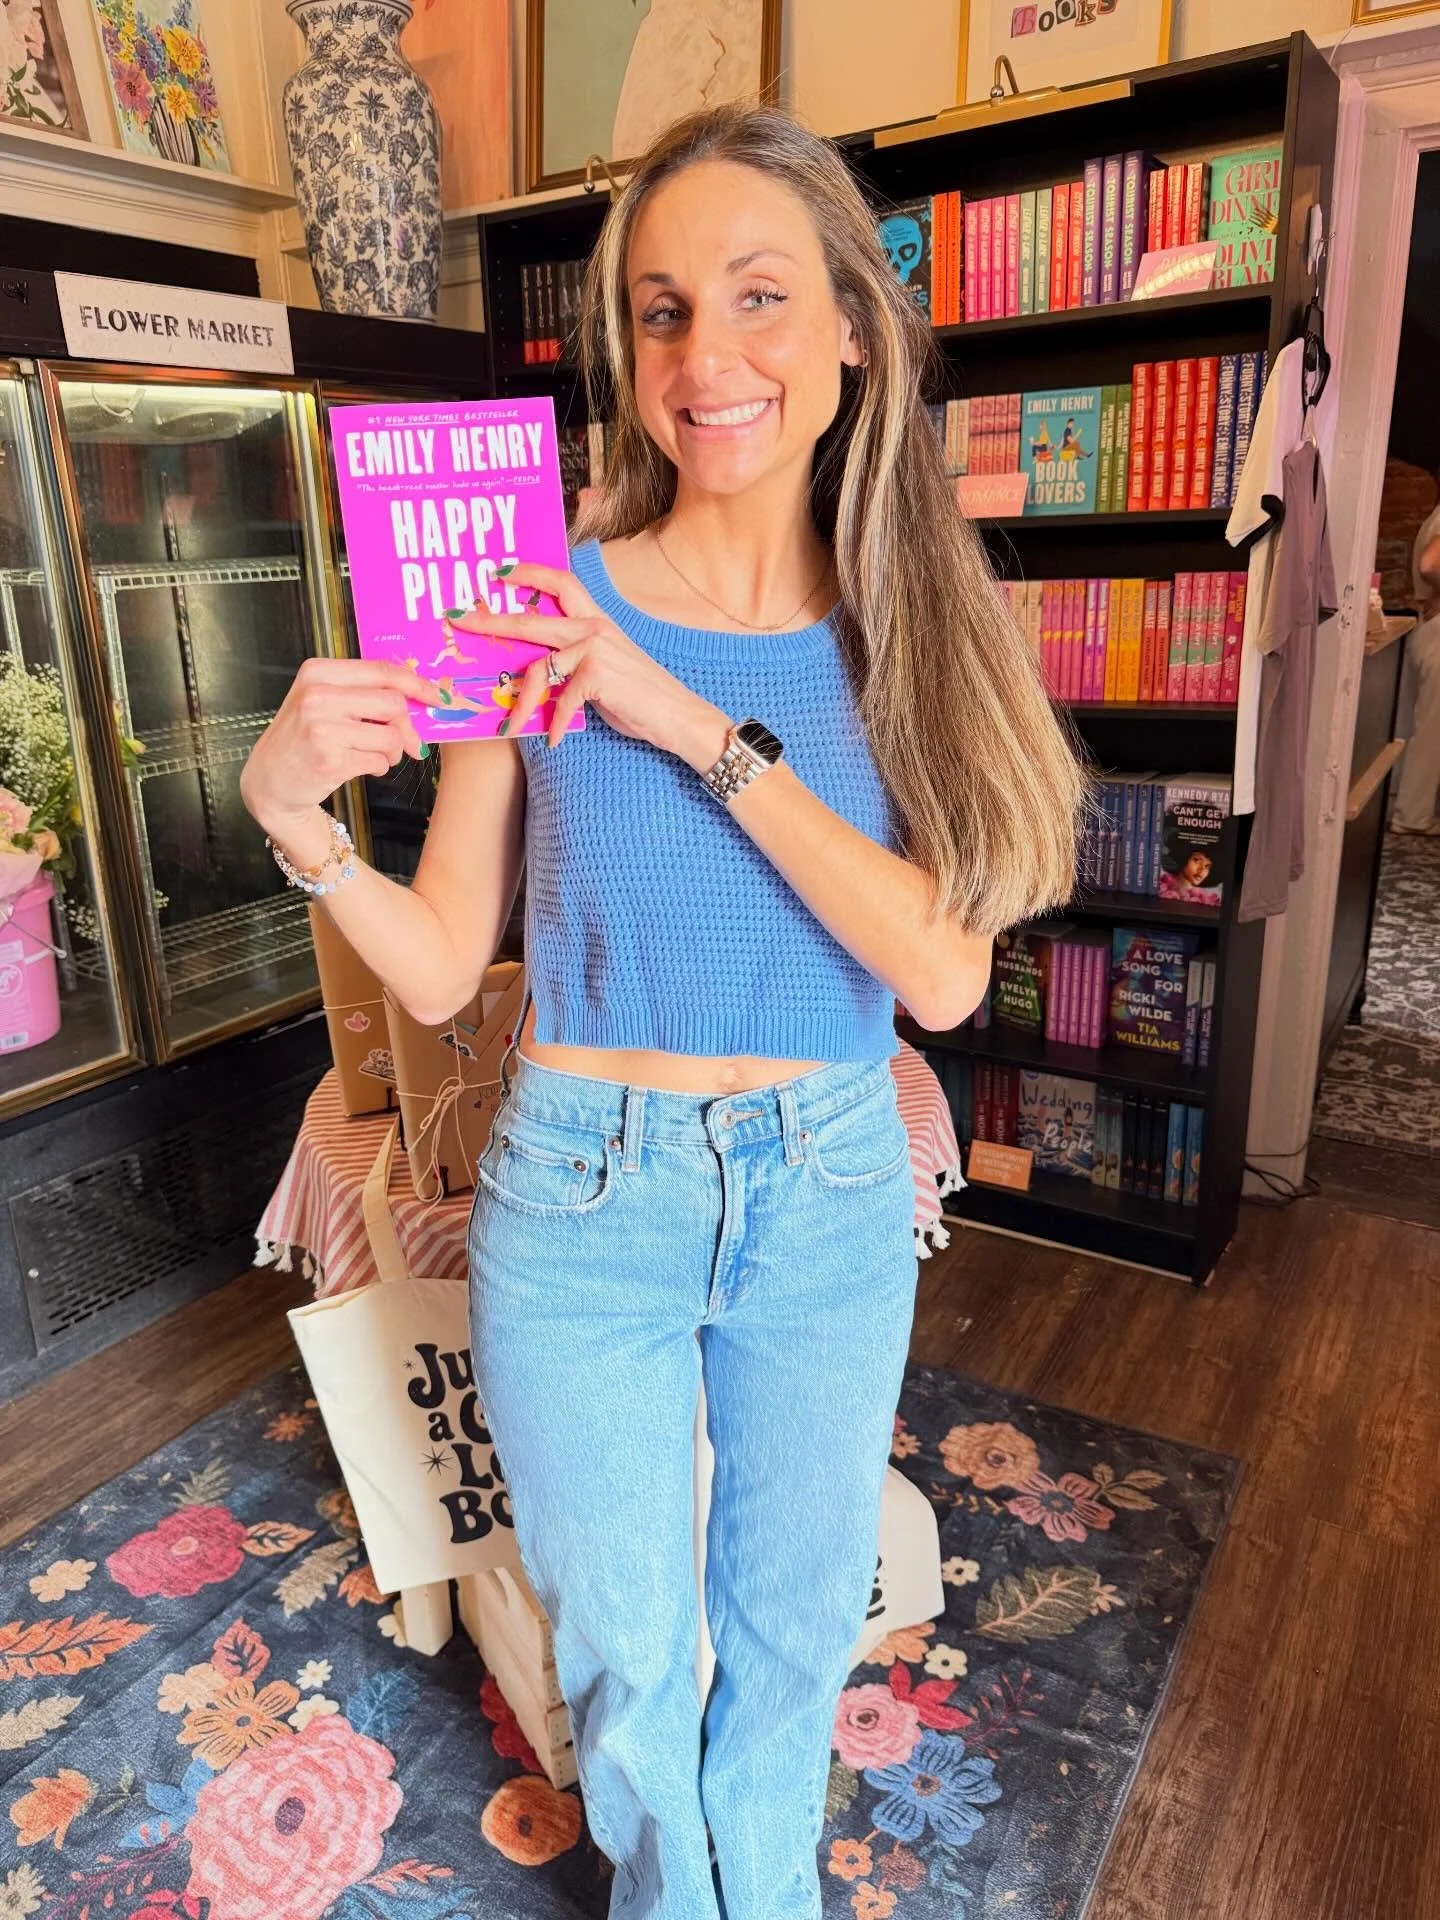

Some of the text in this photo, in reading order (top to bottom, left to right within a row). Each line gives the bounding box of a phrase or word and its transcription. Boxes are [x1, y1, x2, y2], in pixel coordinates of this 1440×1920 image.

[1211, 263, 1272, 289] BLAK
[79, 305, 274, 347] FLOWER MARKET
[1027, 398, 1057, 414] EMILY
[1060, 394, 1094, 411] HENRY
[1218, 366, 1235, 426] FUNNY STORY
[1238, 362, 1256, 424] FUNNY STORY
[385, 415, 406, 424] NEW
[408, 414, 430, 423] YORK
[433, 413, 460, 423] TIMES
[464, 410, 520, 421] BESTSELLER
[345, 421, 543, 477] EMILY HENRY
[1236, 435, 1248, 461] EMILY
[1035, 459, 1080, 482] BOOK
[1214, 437, 1228, 493] EMILY HENRY
[1026, 481, 1086, 504] LOVERS
[390, 494, 516, 559] HAPPY
[401, 557, 525, 621] PLACE
[1166, 787, 1207, 800] KENNEDY
[1211, 791, 1230, 802] RYA
[1173, 806, 1225, 819] CAN'T GET
[1177, 816, 1222, 829] ENOUGH
[997, 960, 1042, 977] HUSBANDS
[1122, 961, 1161, 976] SONG
[1133, 950, 1184, 965] A LOVE
[1000, 981, 1037, 997] EVELYN
[1119, 989, 1156, 1005] RICKI
[1154, 980, 1184, 994] FOR
[1003, 995, 1033, 1009] HUGO
[1128, 1005, 1173, 1022] WILDE
[1137, 1022, 1160, 1035] TIA
[1116, 1031, 1181, 1051] WILLIAMS
[1022, 1083, 1093, 1120] Wedding
[1043, 1123, 1093, 1157] People
[408, 1343, 476, 1408] Ju
[428, 1411, 456, 1442] a
[439, 1489, 515, 1544] Bo
